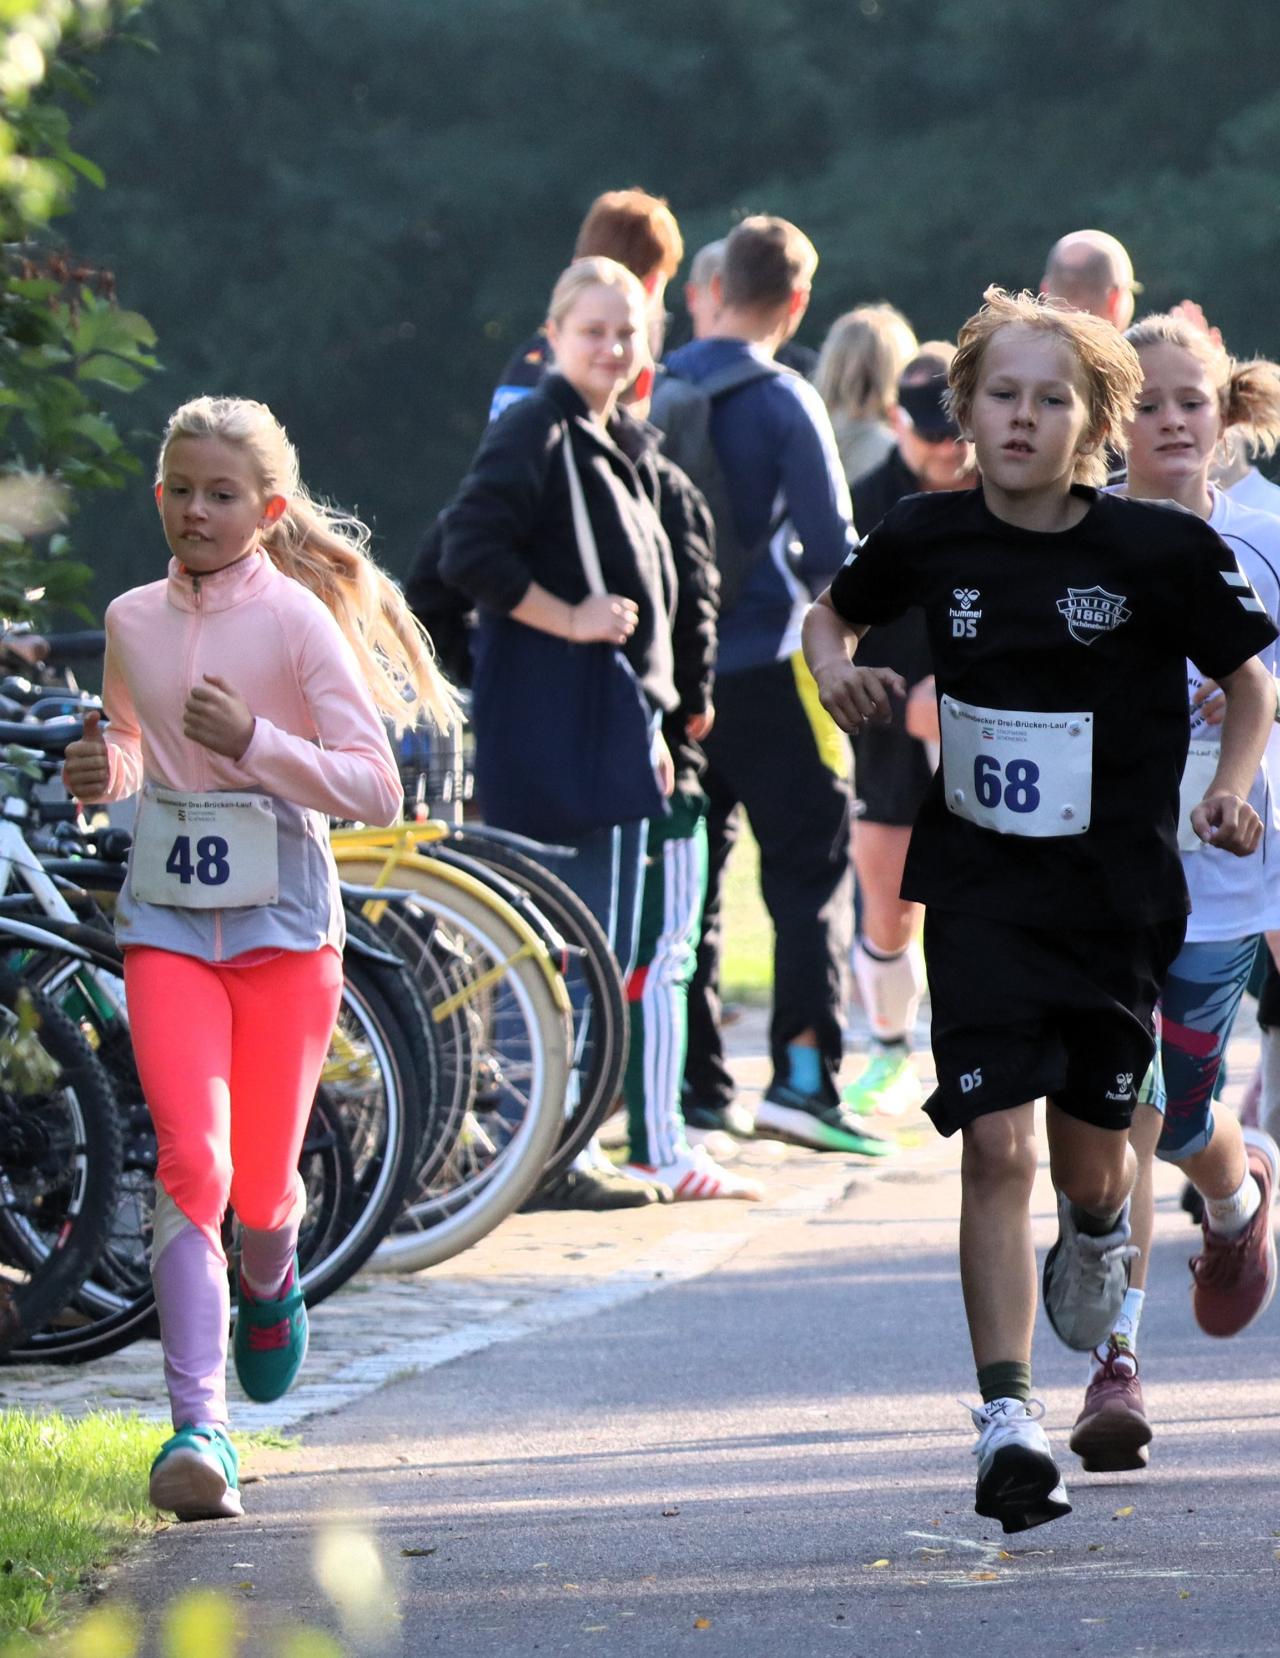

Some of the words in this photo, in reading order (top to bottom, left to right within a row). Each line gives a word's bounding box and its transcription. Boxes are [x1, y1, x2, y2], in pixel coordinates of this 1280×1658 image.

[949, 608, 982, 618] hummel
[1067, 598, 1122, 616] UNION
[1076, 609, 1111, 624] 1861
[952, 618, 977, 638] DS
[957, 711, 996, 725] chönebecker
[997, 718, 1068, 729] Drei-Brücken-Lauf
[974, 754, 1041, 814] 68
[166, 835, 230, 886] 48
[959, 1068, 983, 1094] DS
